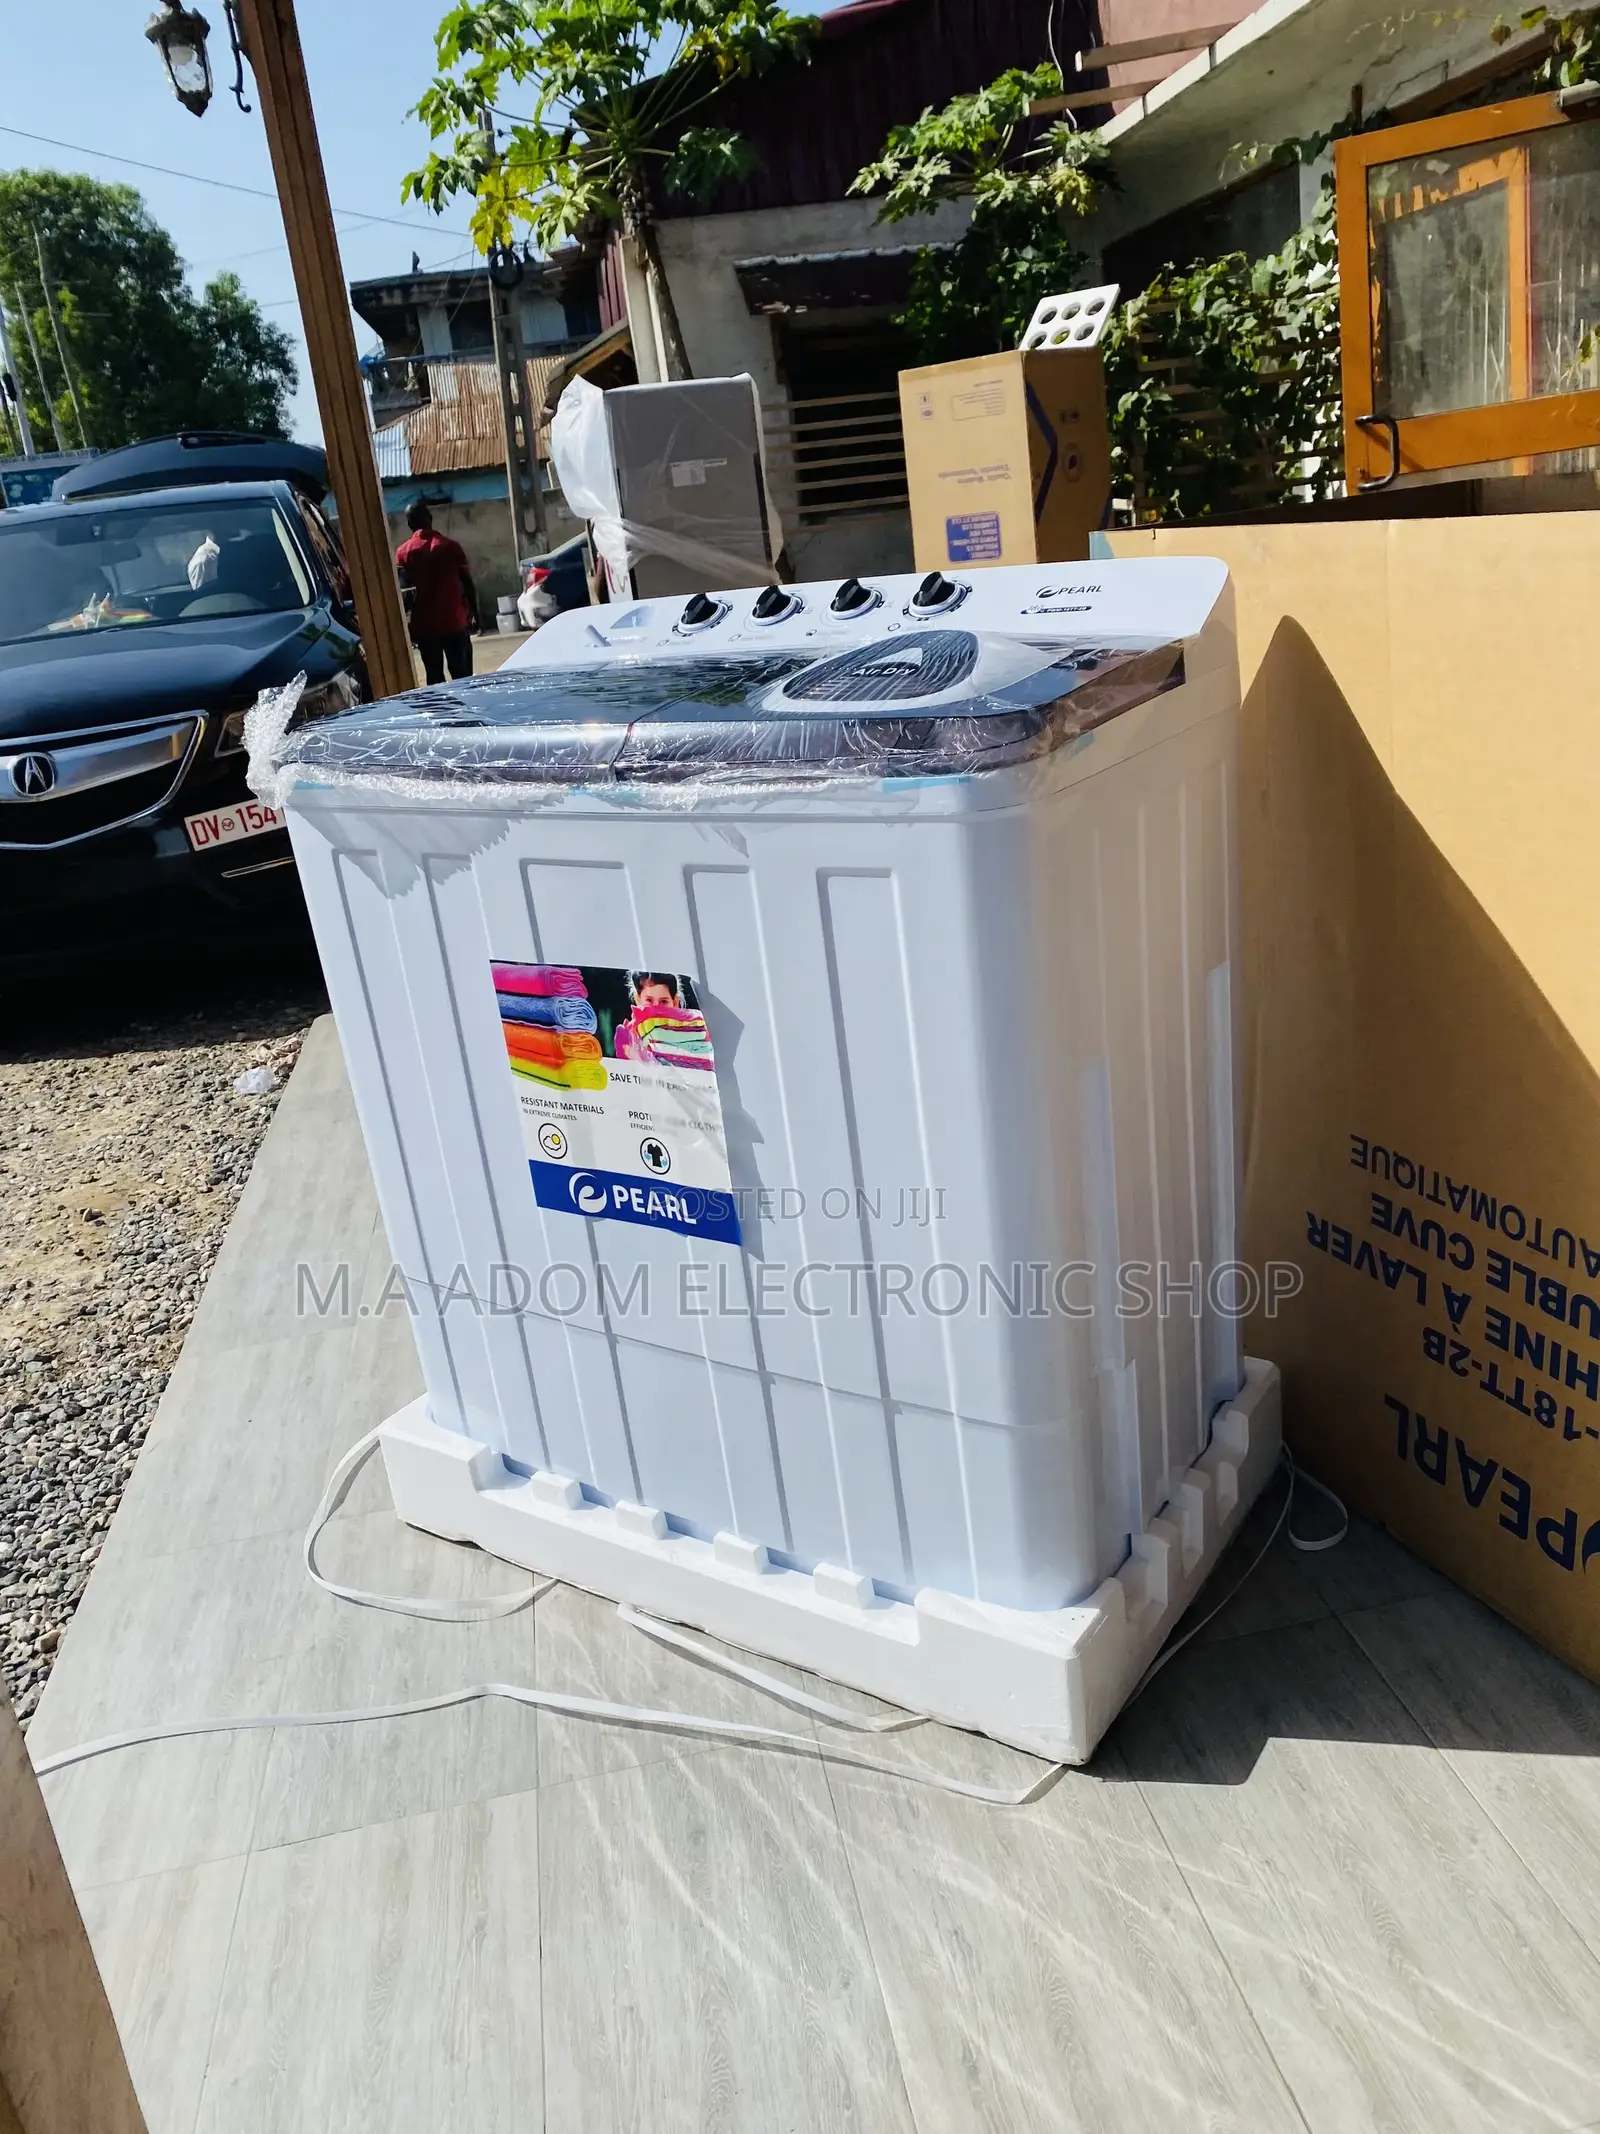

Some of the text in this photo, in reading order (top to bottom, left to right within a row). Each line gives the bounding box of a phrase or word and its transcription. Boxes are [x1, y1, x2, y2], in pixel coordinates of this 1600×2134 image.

[1058, 584, 1103, 595] PEARL
[851, 667, 916, 677] Air Dry
[190, 814, 220, 846] DV
[609, 1072, 632, 1084] SAVE
[520, 1096, 605, 1115] RESISTANT MATERIALS
[528, 1109, 551, 1118] EXTREME
[551, 1112, 578, 1121] CLIMATES
[612, 1184, 697, 1225] PEARL
[1350, 1134, 1600, 1279] AUTOMATIQUE
[1371, 1192, 1475, 1271] CUVE
[1306, 1210, 1600, 1401] HINE À LAVER
[1384, 1393, 1578, 1572] PEARL
